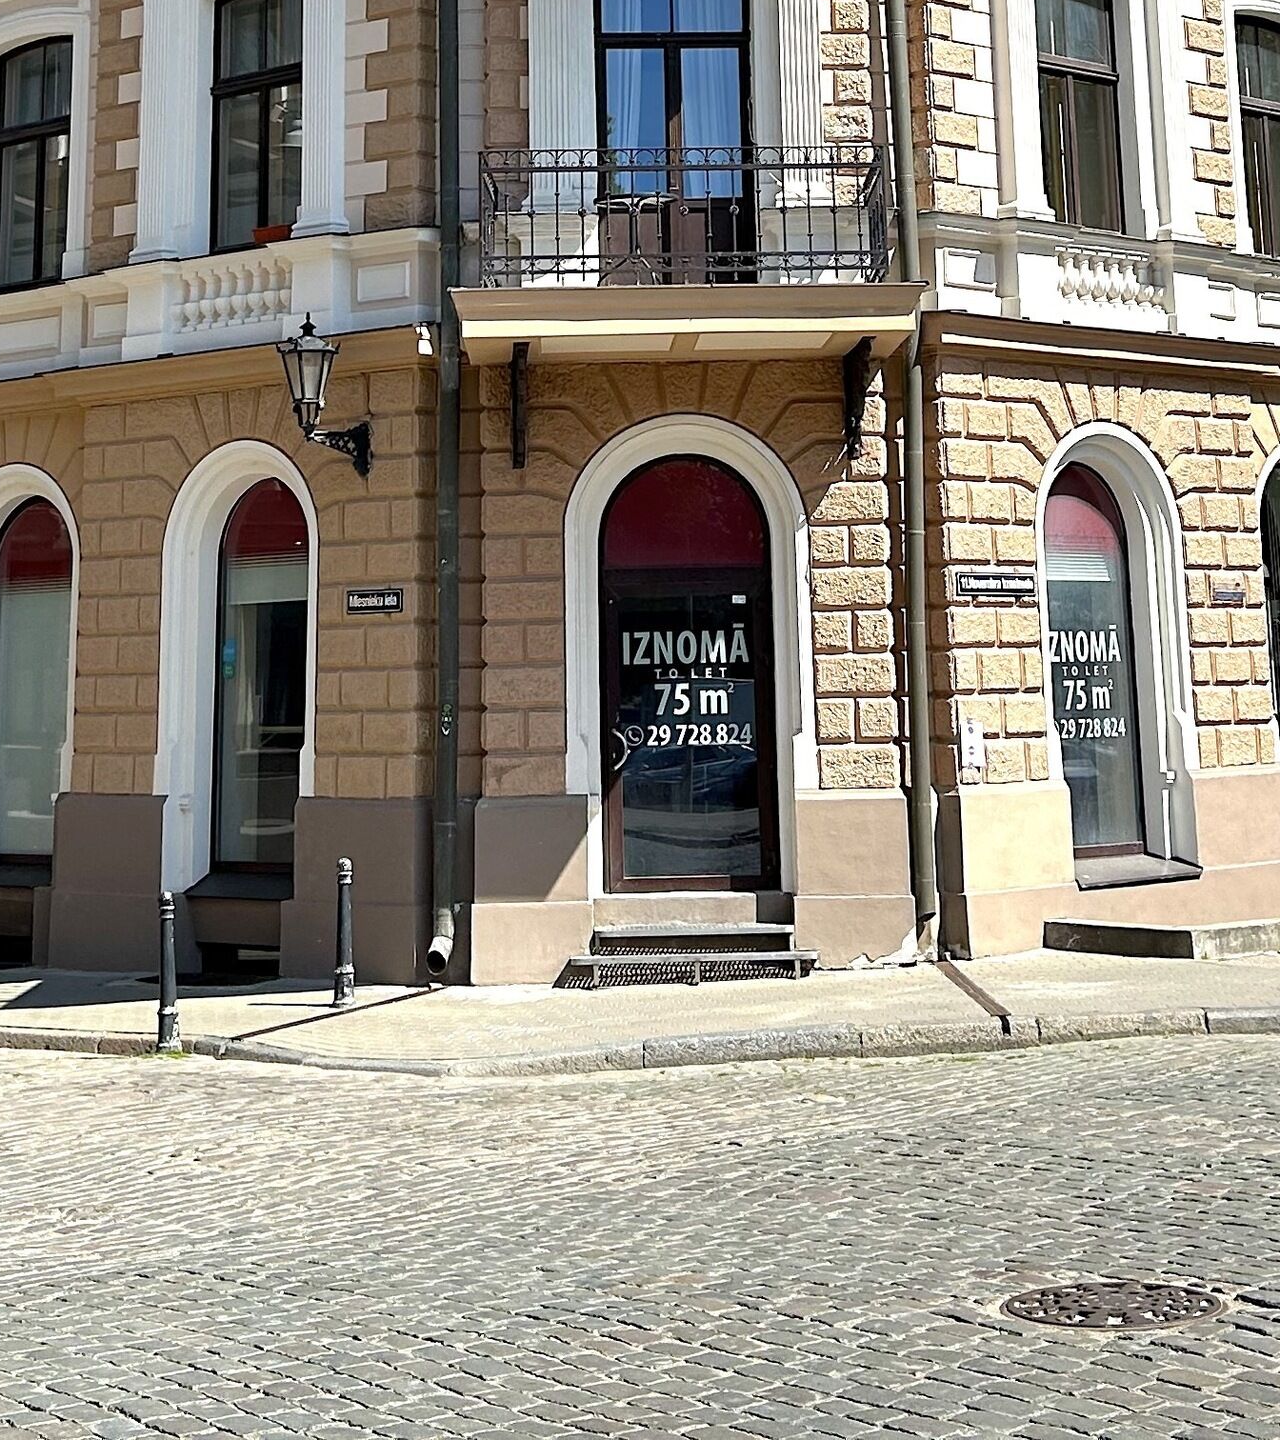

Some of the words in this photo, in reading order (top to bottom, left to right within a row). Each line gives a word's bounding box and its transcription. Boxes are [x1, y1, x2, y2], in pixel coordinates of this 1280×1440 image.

[622, 623, 750, 666] IZNOMĀ
[654, 668, 678, 680] TO
[690, 667, 728, 679] LET
[1062, 665, 1079, 677] TO
[1085, 665, 1109, 676] LET
[654, 682, 691, 716] 75
[1062, 679, 1087, 711] 75
[646, 724, 671, 747] 29
[675, 723, 712, 746] 728
[716, 722, 753, 745] 824
[1060, 718, 1077, 739] 29
[1078, 717, 1102, 738] 728
[1103, 717, 1127, 737] 824
